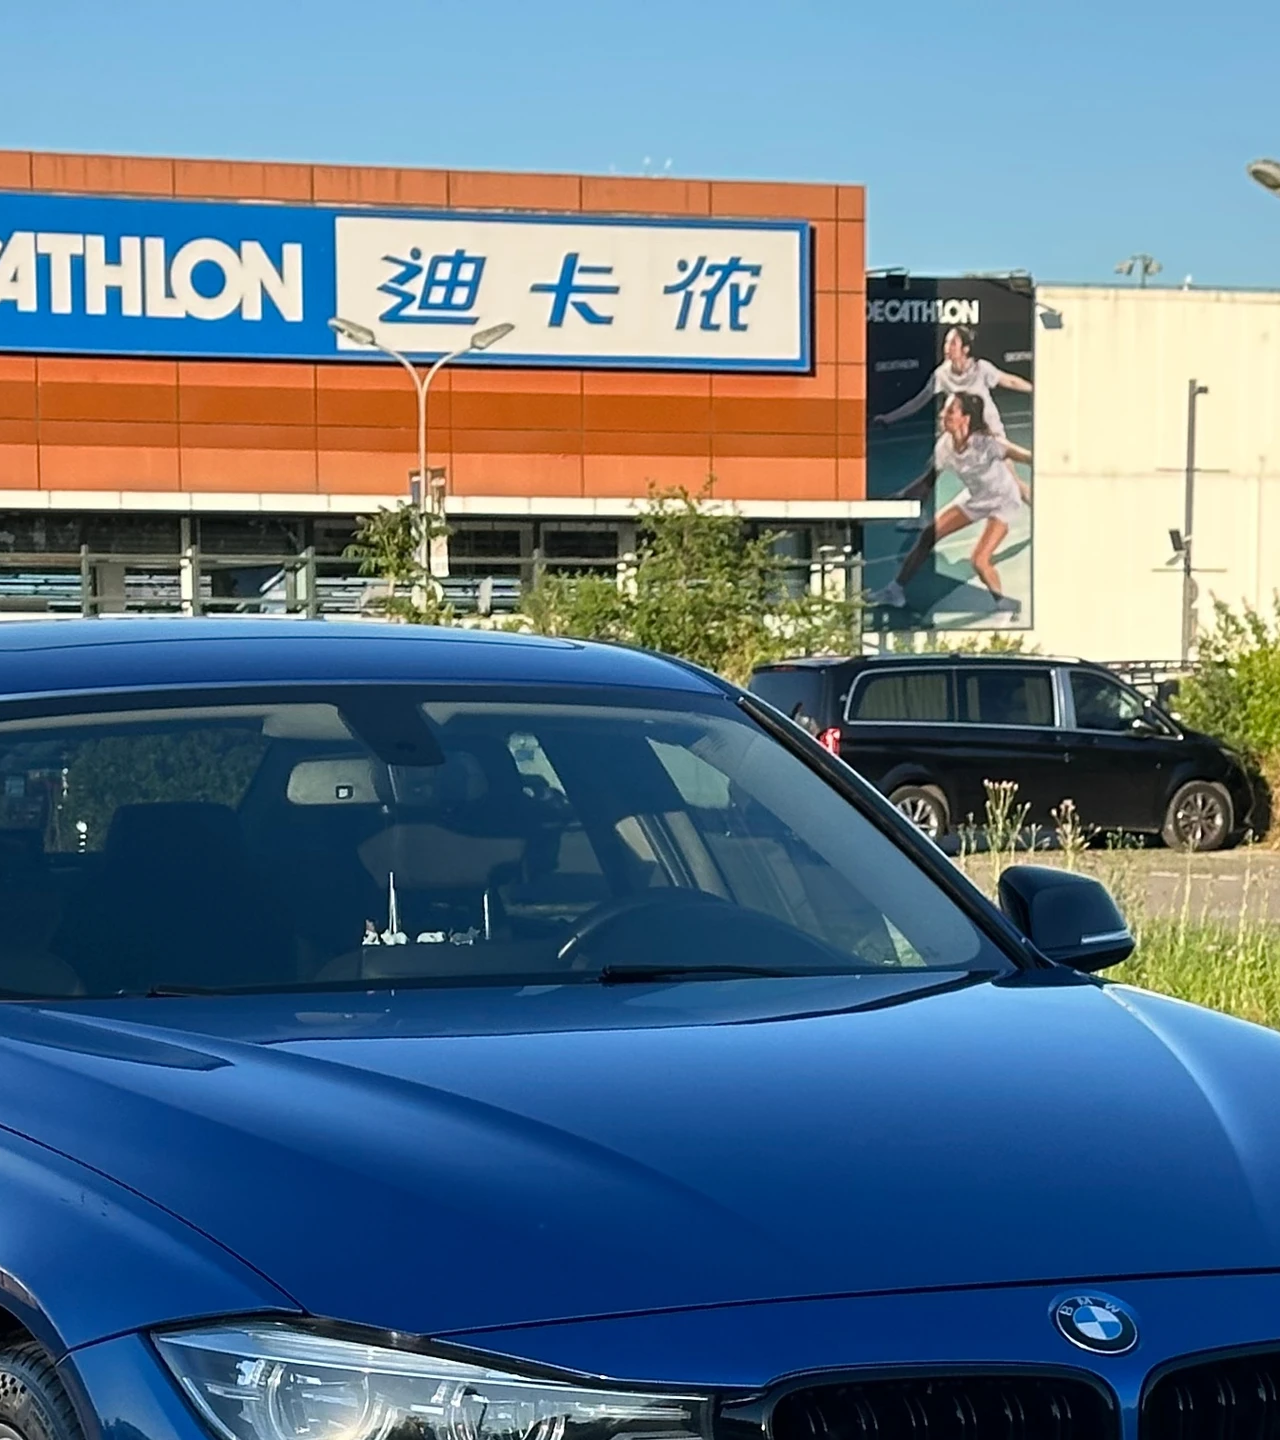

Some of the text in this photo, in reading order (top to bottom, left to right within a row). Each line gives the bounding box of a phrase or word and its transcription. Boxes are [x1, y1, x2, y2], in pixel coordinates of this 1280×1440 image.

[376, 246, 763, 332] 迪卡侬
[1059, 1297, 1121, 1316] BMW
